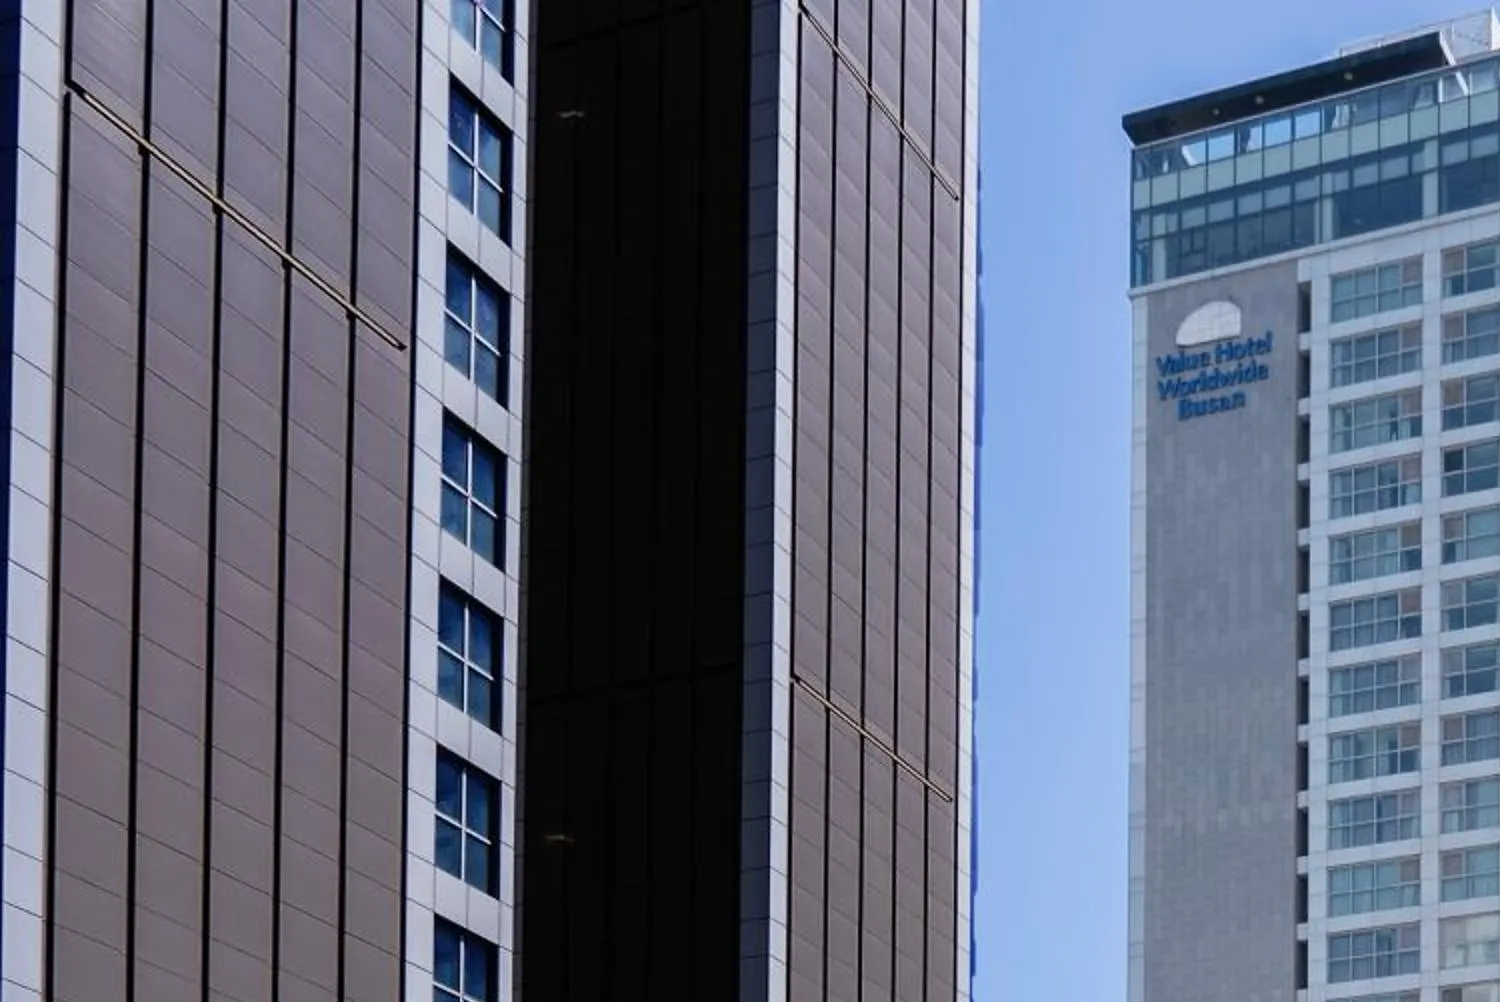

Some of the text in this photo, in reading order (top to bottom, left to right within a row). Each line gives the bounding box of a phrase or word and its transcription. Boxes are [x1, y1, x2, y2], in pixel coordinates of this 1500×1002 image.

[1155, 330, 1273, 378] Value Hotel
[1156, 360, 1270, 401] Worldwide
[1177, 392, 1246, 421] Busan
